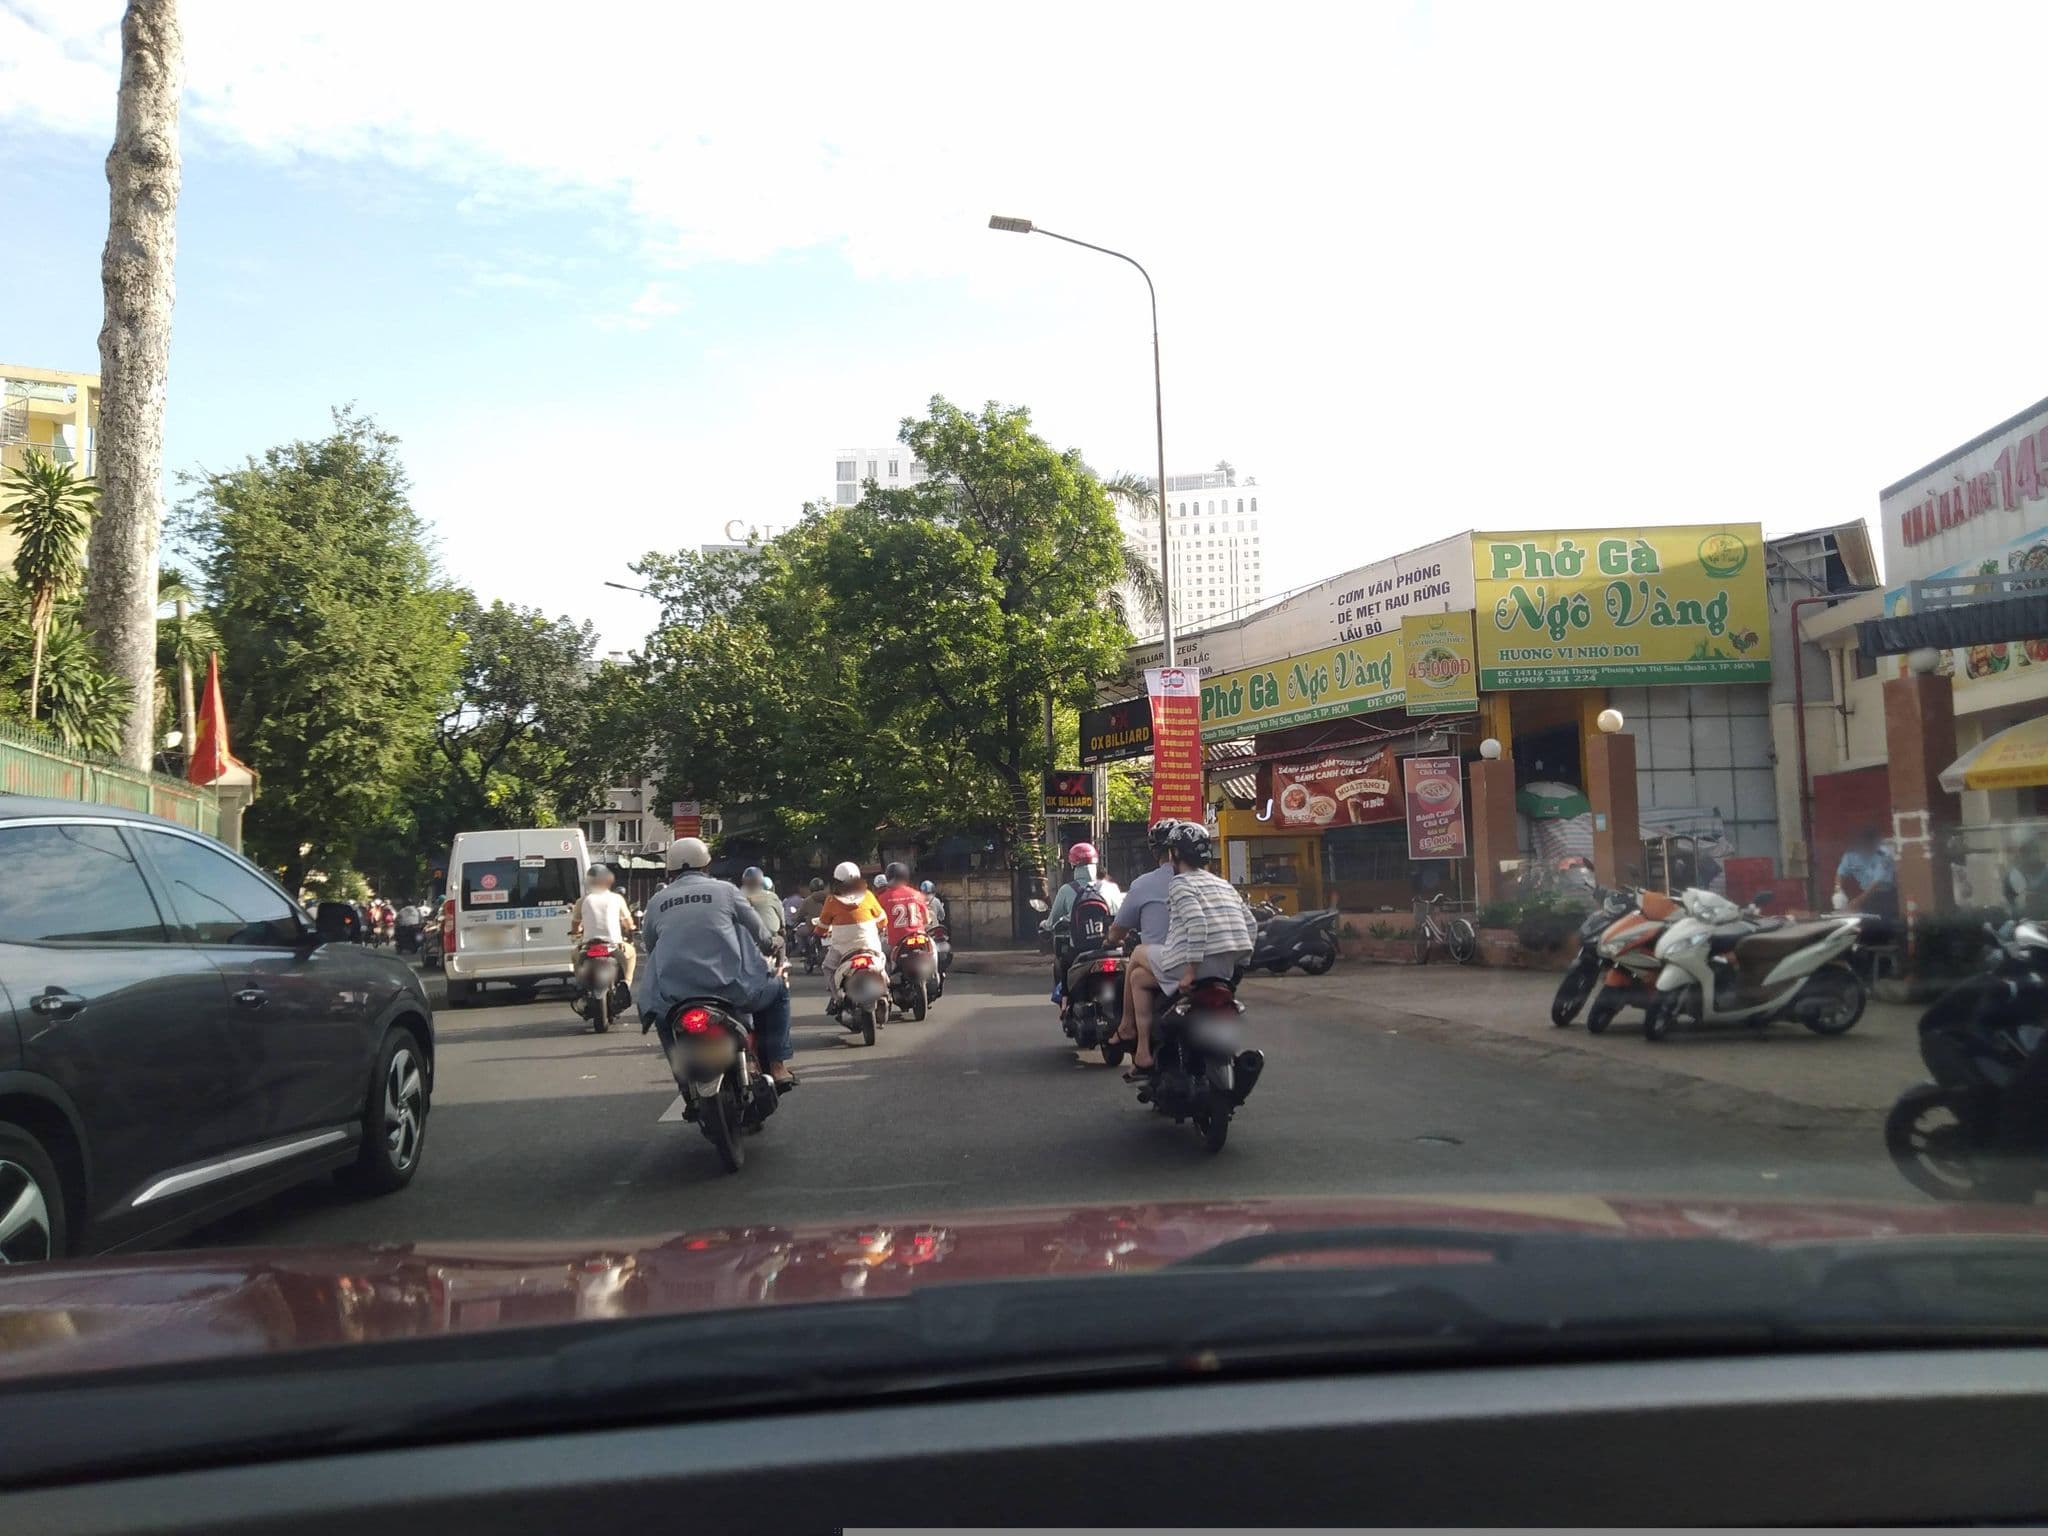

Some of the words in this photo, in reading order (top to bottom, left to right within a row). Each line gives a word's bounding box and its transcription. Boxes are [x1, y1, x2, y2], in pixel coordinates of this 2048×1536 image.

[1490, 540, 1586, 578] Phở
[1598, 539, 1661, 575] Gà
[1337, 588, 1364, 606] CƠM
[1368, 579, 1393, 597] VĂN
[1396, 563, 1441, 588] PHÒNG
[1385, 592, 1409, 611] RAU
[1495, 585, 1591, 641] Ngô
[1605, 580, 1728, 636] Vàng
[1176, 642, 1198, 655] ZEUS
[1200, 679, 1244, 721] Phở
[1249, 672, 1280, 711] Gà
[1287, 663, 1329, 705] Ngô
[1334, 649, 1392, 690] Vàng
[1331, 703, 1349, 715] HCM
[1090, 737, 1105, 751] OX
[1105, 726, 1150, 749] BILLIARD
[1058, 796, 1093, 808] BILLIARD
[659, 894, 713, 913] dialog
[1085, 918, 1104, 935] ila
